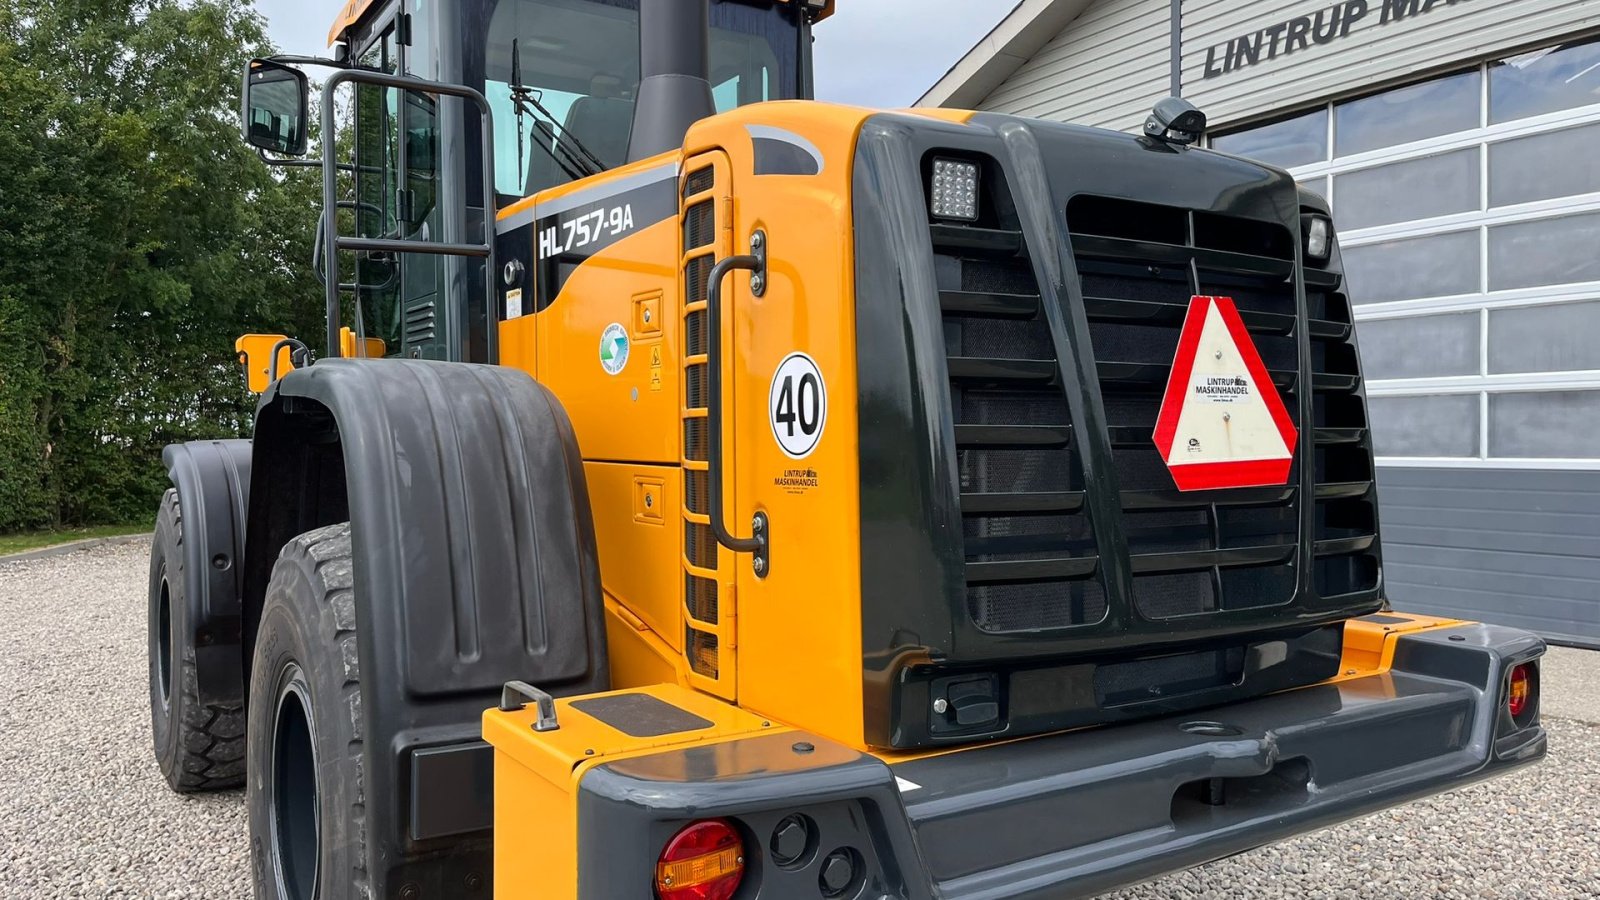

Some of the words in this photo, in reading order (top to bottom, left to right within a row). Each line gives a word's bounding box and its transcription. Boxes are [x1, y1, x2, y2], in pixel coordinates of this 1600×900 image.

[1203, 0, 1368, 79] LINTRUP
[540, 203, 634, 260] HL757-9A
[1207, 377, 1235, 386] LINTRUP
[1195, 386, 1249, 395] MASKINHANDEL
[776, 372, 820, 437] 40
[784, 469, 807, 478] LINTRUP
[774, 477, 818, 487] MASKINHANDEL
